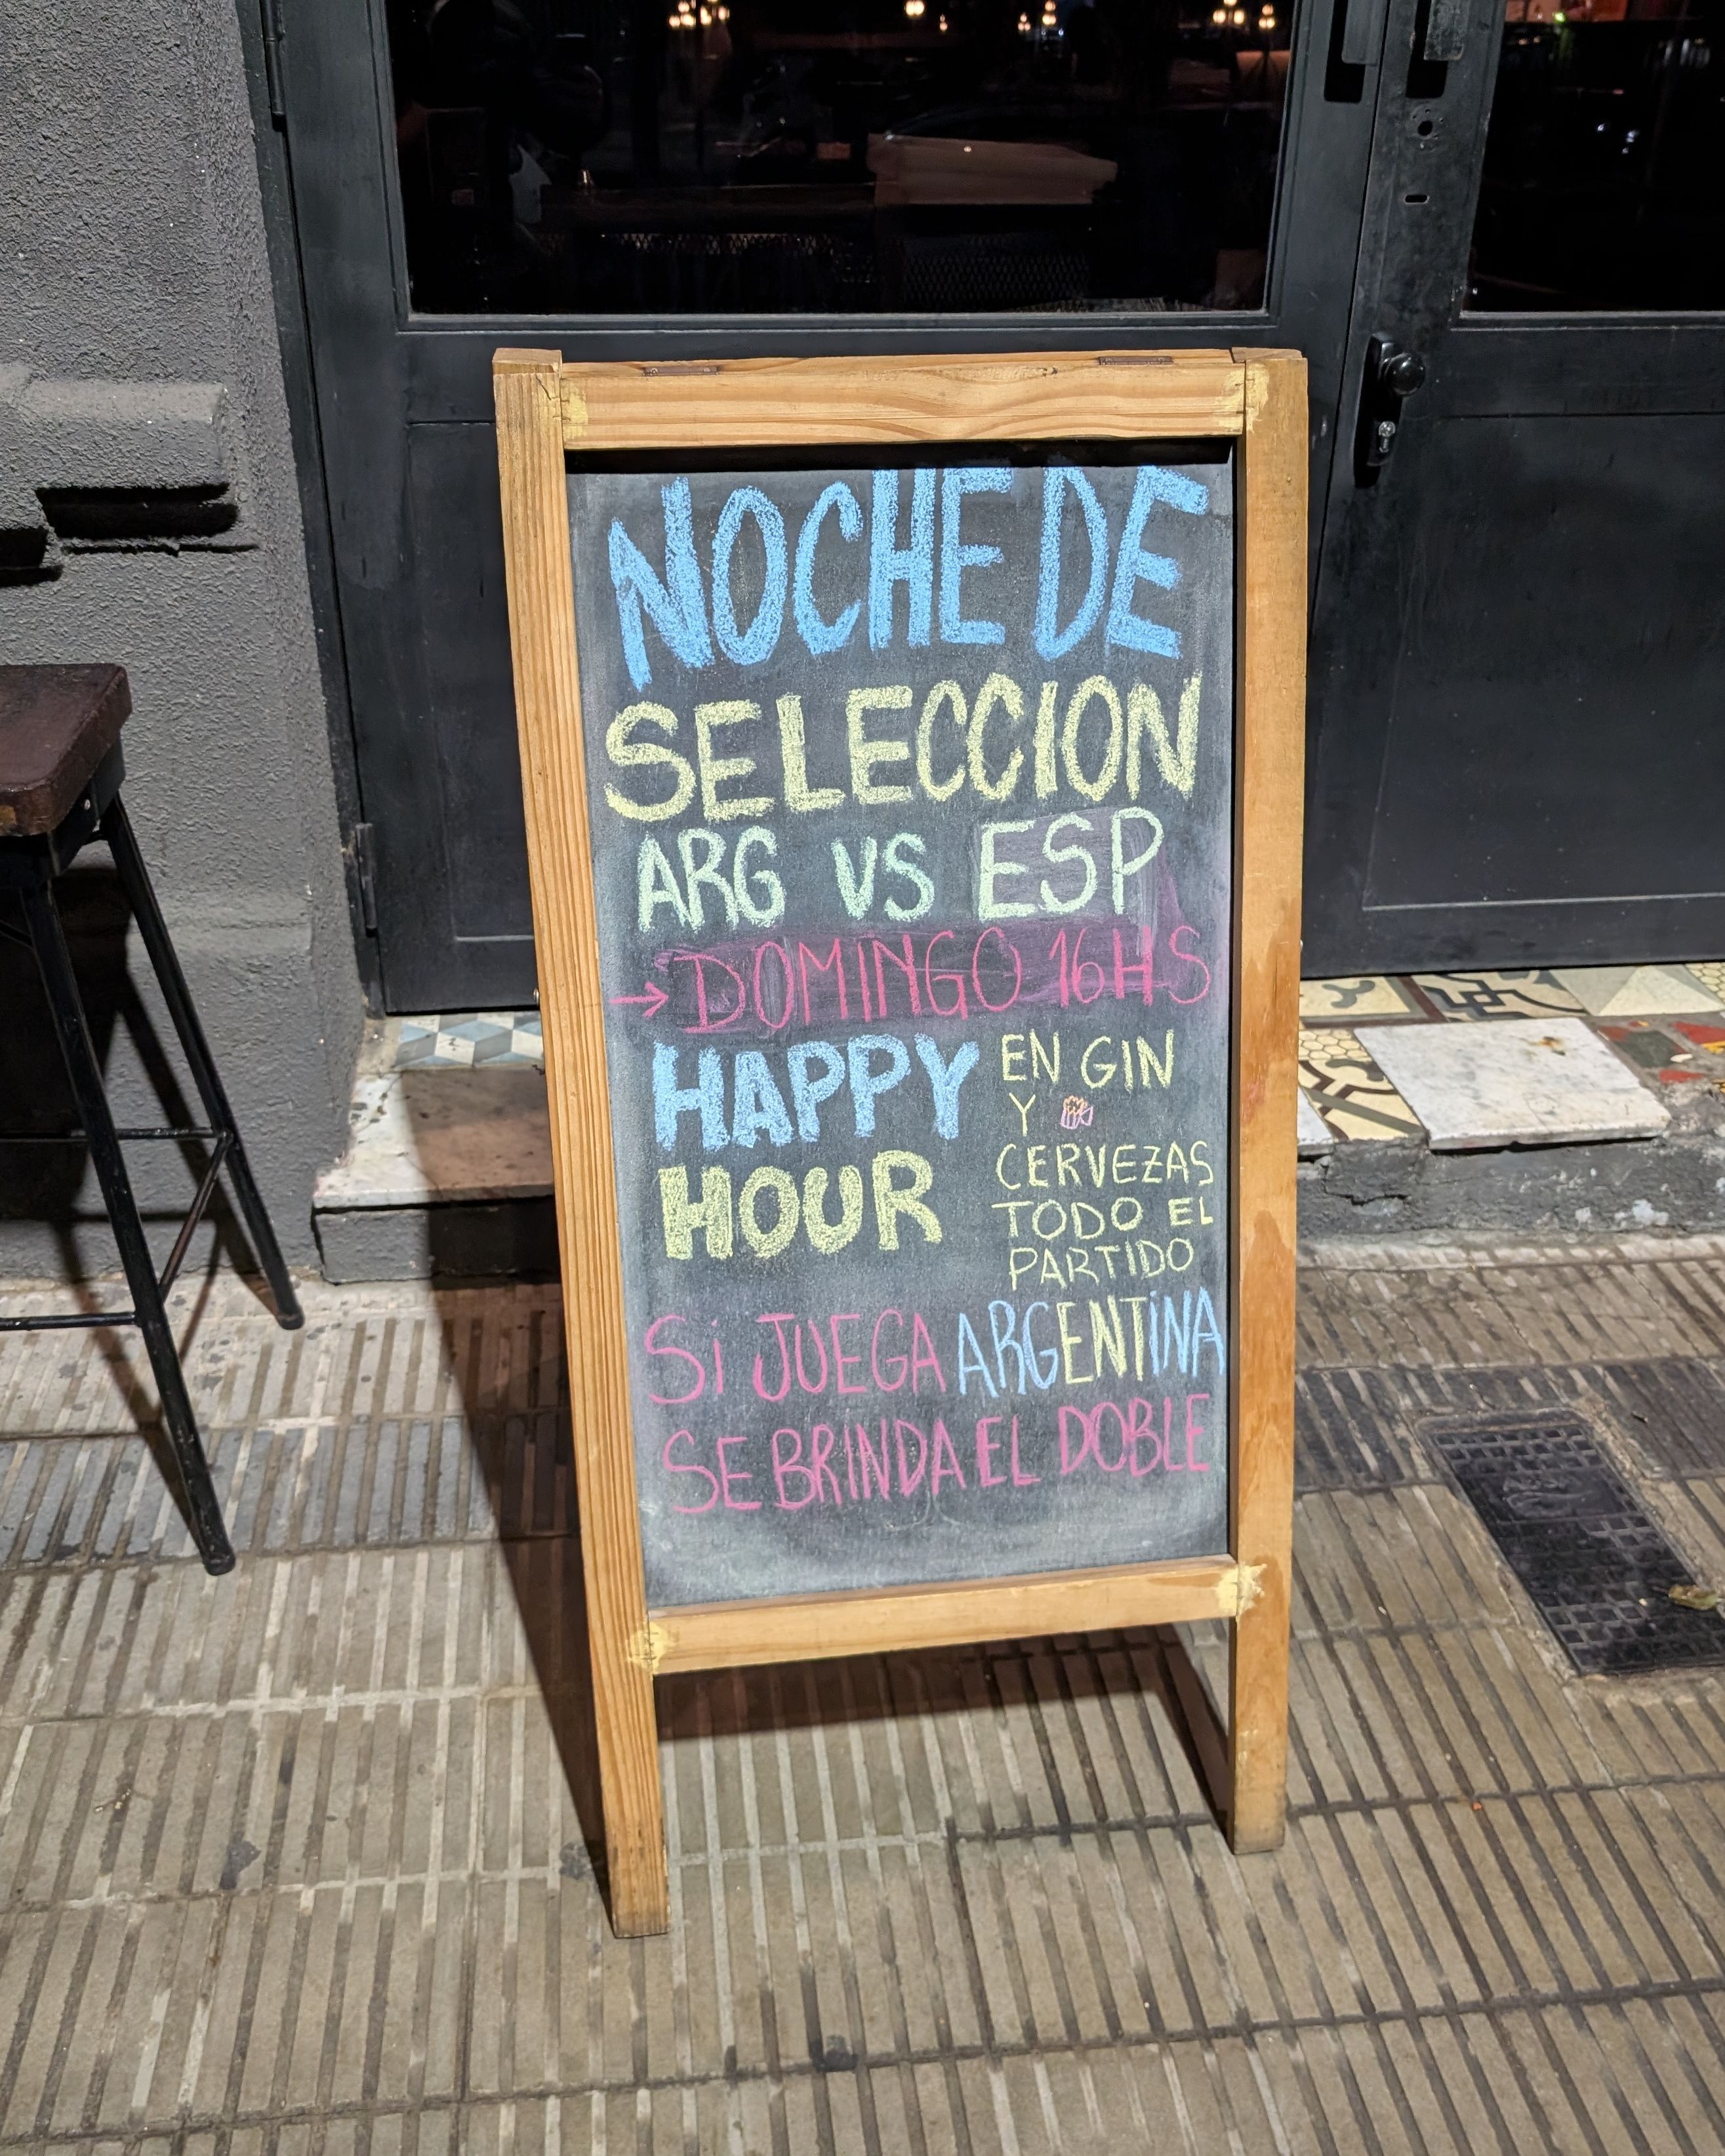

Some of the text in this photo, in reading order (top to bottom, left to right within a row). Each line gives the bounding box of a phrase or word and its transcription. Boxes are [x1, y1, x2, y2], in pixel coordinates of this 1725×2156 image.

[607, 466, 1209, 692] NOCHE DE
[605, 671, 1203, 822] SELECCION
[638, 807, 1166, 932] ARG VS ESP
[672, 925, 1211, 1034] DOMINGO 16HS
[652, 1033, 980, 1153] HAPPY
[1002, 1029, 1174, 1092] EN GIN
[1009, 1092, 1036, 1136] Y
[659, 1149, 943, 1260] HOUR
[991, 1195, 1213, 1241] TODO EL
[996, 1140, 1214, 1190] CERVEZAS
[1009, 1237, 1194, 1291] PARTIDO
[753, 1309, 947, 1401] JUEGA
[662, 1428, 763, 1514] SE
[976, 1416, 1041, 1488] EL
[1058, 1393, 1211, 1477] DOBLE
